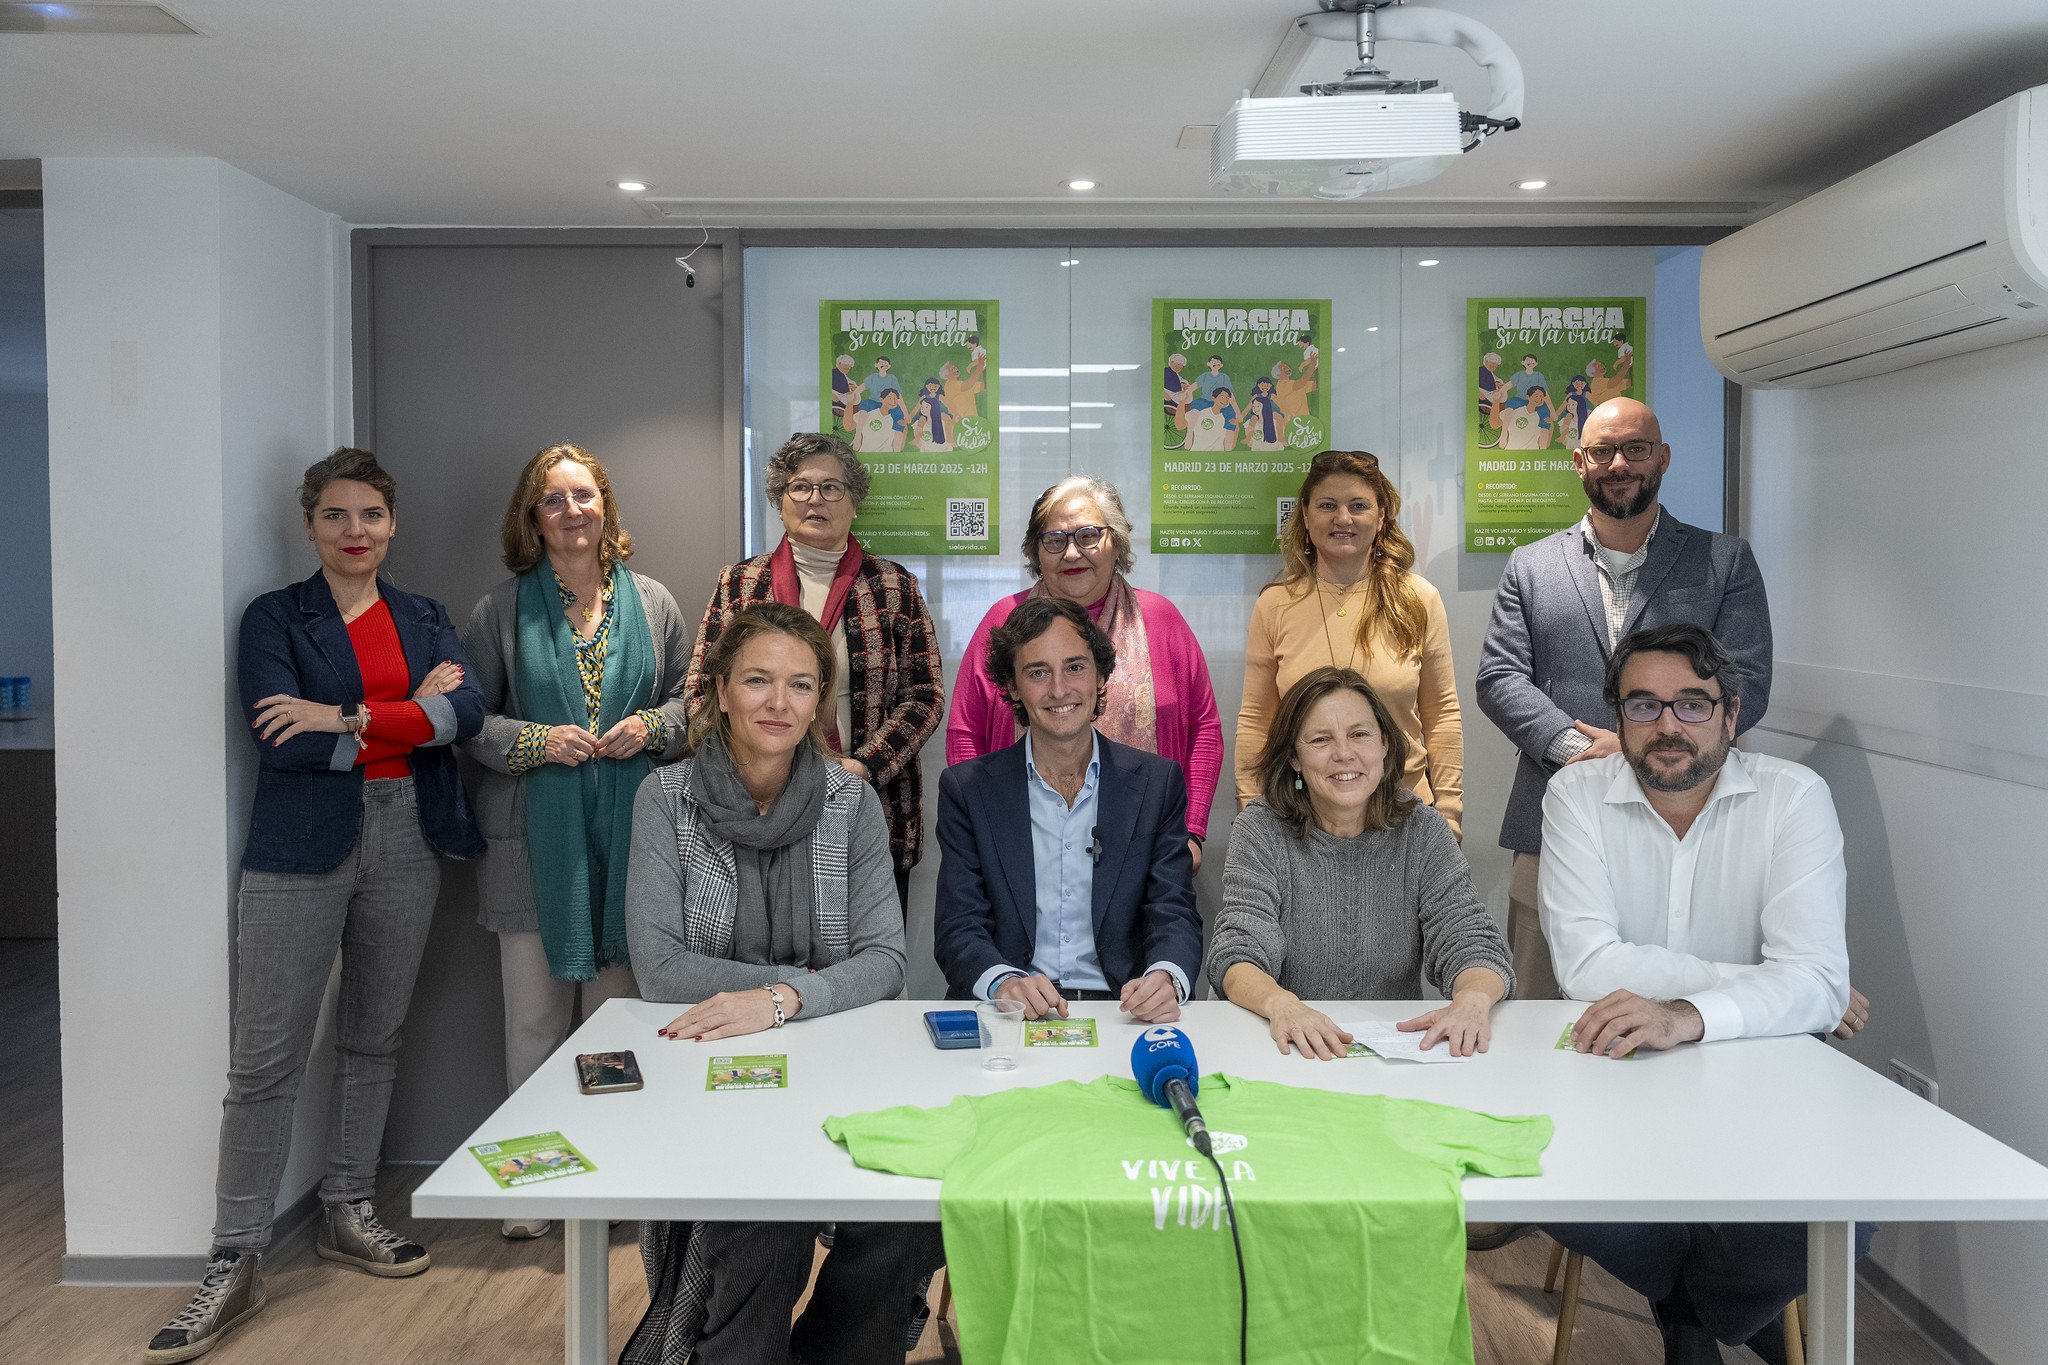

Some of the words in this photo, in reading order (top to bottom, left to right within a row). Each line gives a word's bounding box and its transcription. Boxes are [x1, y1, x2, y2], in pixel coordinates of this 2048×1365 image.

[841, 310, 978, 332] MARCHA
[1174, 309, 1310, 330] MARCHA
[1488, 307, 1624, 330] MARCHA
[872, 331, 890, 346] a
[893, 318, 918, 350] la
[922, 317, 967, 346] vida
[1204, 329, 1222, 345] a
[1225, 317, 1250, 348] la
[1253, 316, 1301, 346] vida
[1520, 328, 1537, 344] a
[1540, 315, 1565, 346] la
[1569, 314, 1615, 345] vida
[962, 418, 982, 436] Sí
[1293, 416, 1314, 436] Sí
[873, 464, 885, 474] 23
[888, 464, 901, 474] DE
[904, 464, 937, 474] MARZO
[940, 464, 963, 474] 2025
[1164, 462, 1202, 472] MADRID
[1205, 462, 1216, 472] 23
[1220, 462, 1232, 472] DE
[1235, 462, 1268, 472] MARZO
[1271, 462, 1294, 472] 2025
[1479, 461, 1517, 471] MADRID
[1520, 461, 1531, 471] 23
[1534, 461, 1547, 471] DE
[1550, 461, 1575, 471] MARZ
[1148, 1041, 1182, 1052] COPE
[1121, 1160, 1207, 1181] VIVE
[1151, 1185, 1235, 1230] VIDA
